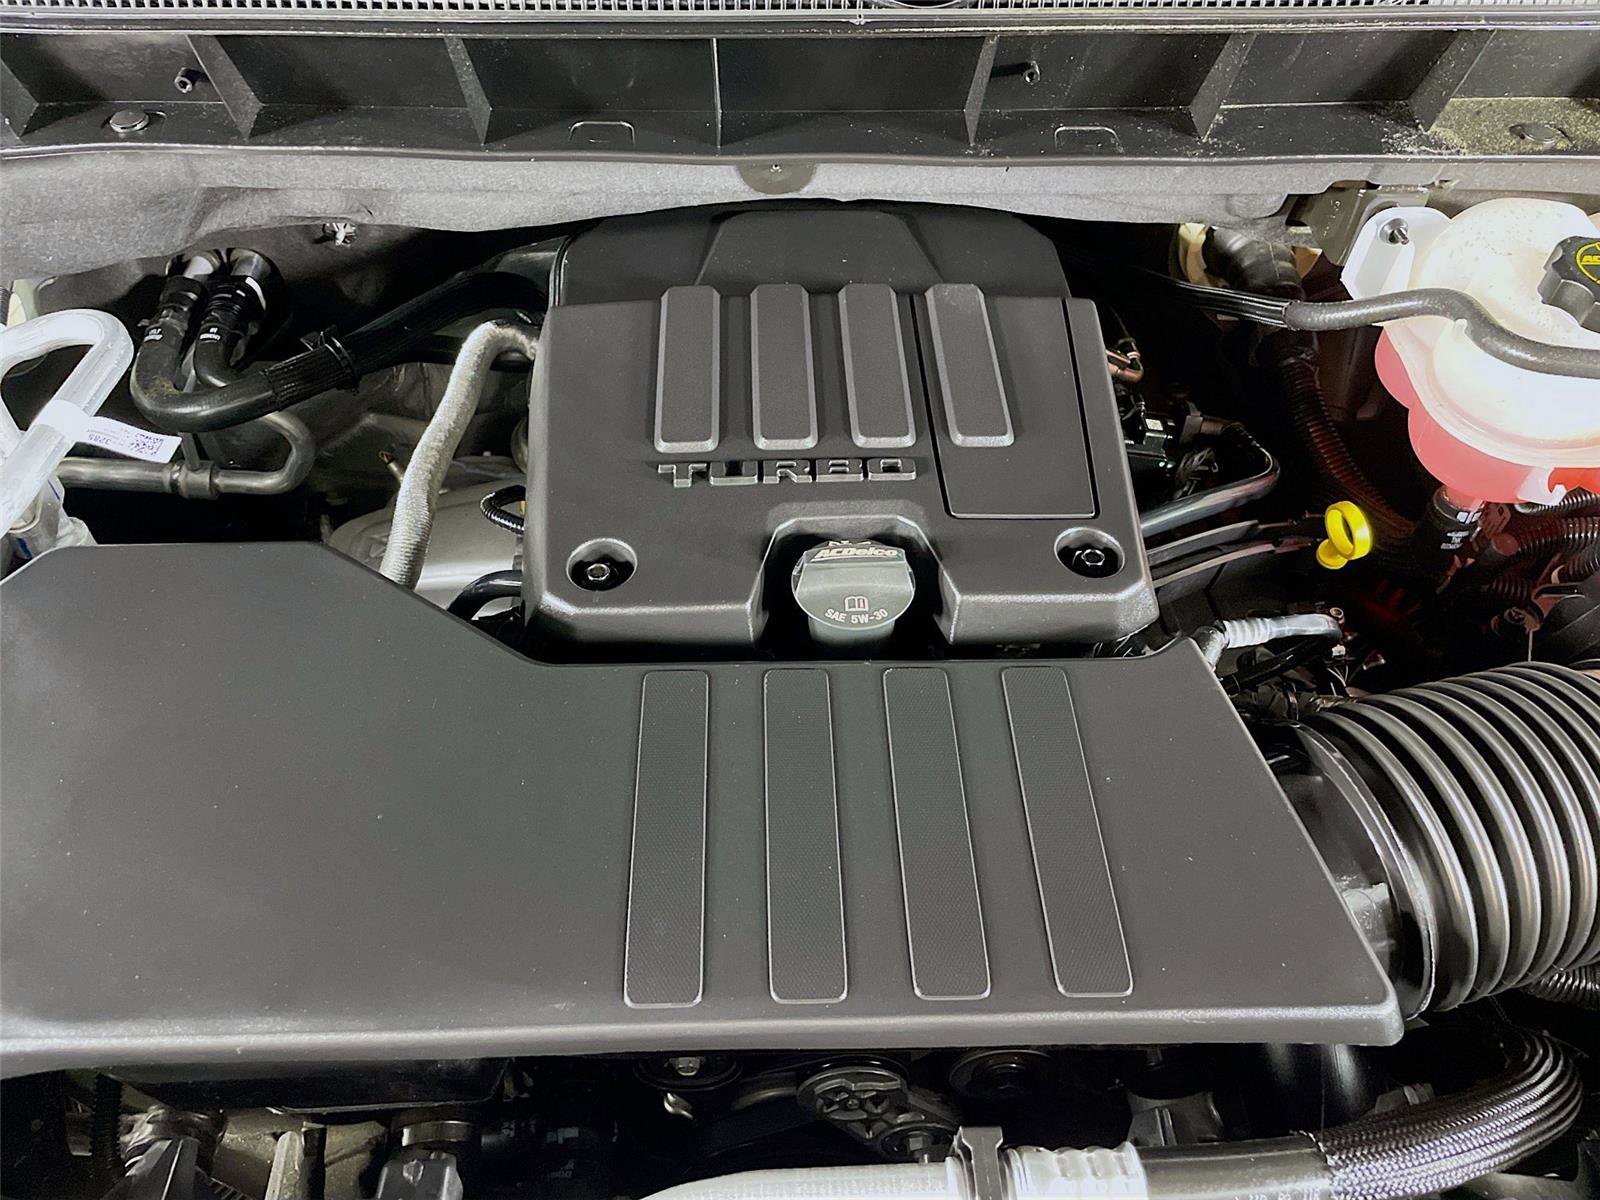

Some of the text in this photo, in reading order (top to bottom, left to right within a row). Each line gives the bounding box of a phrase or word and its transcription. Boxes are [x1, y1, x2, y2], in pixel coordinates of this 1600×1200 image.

[657, 458, 917, 488] TURBO
[814, 547, 898, 559] ACDelco
[825, 608, 889, 624] SAE 5W-30
